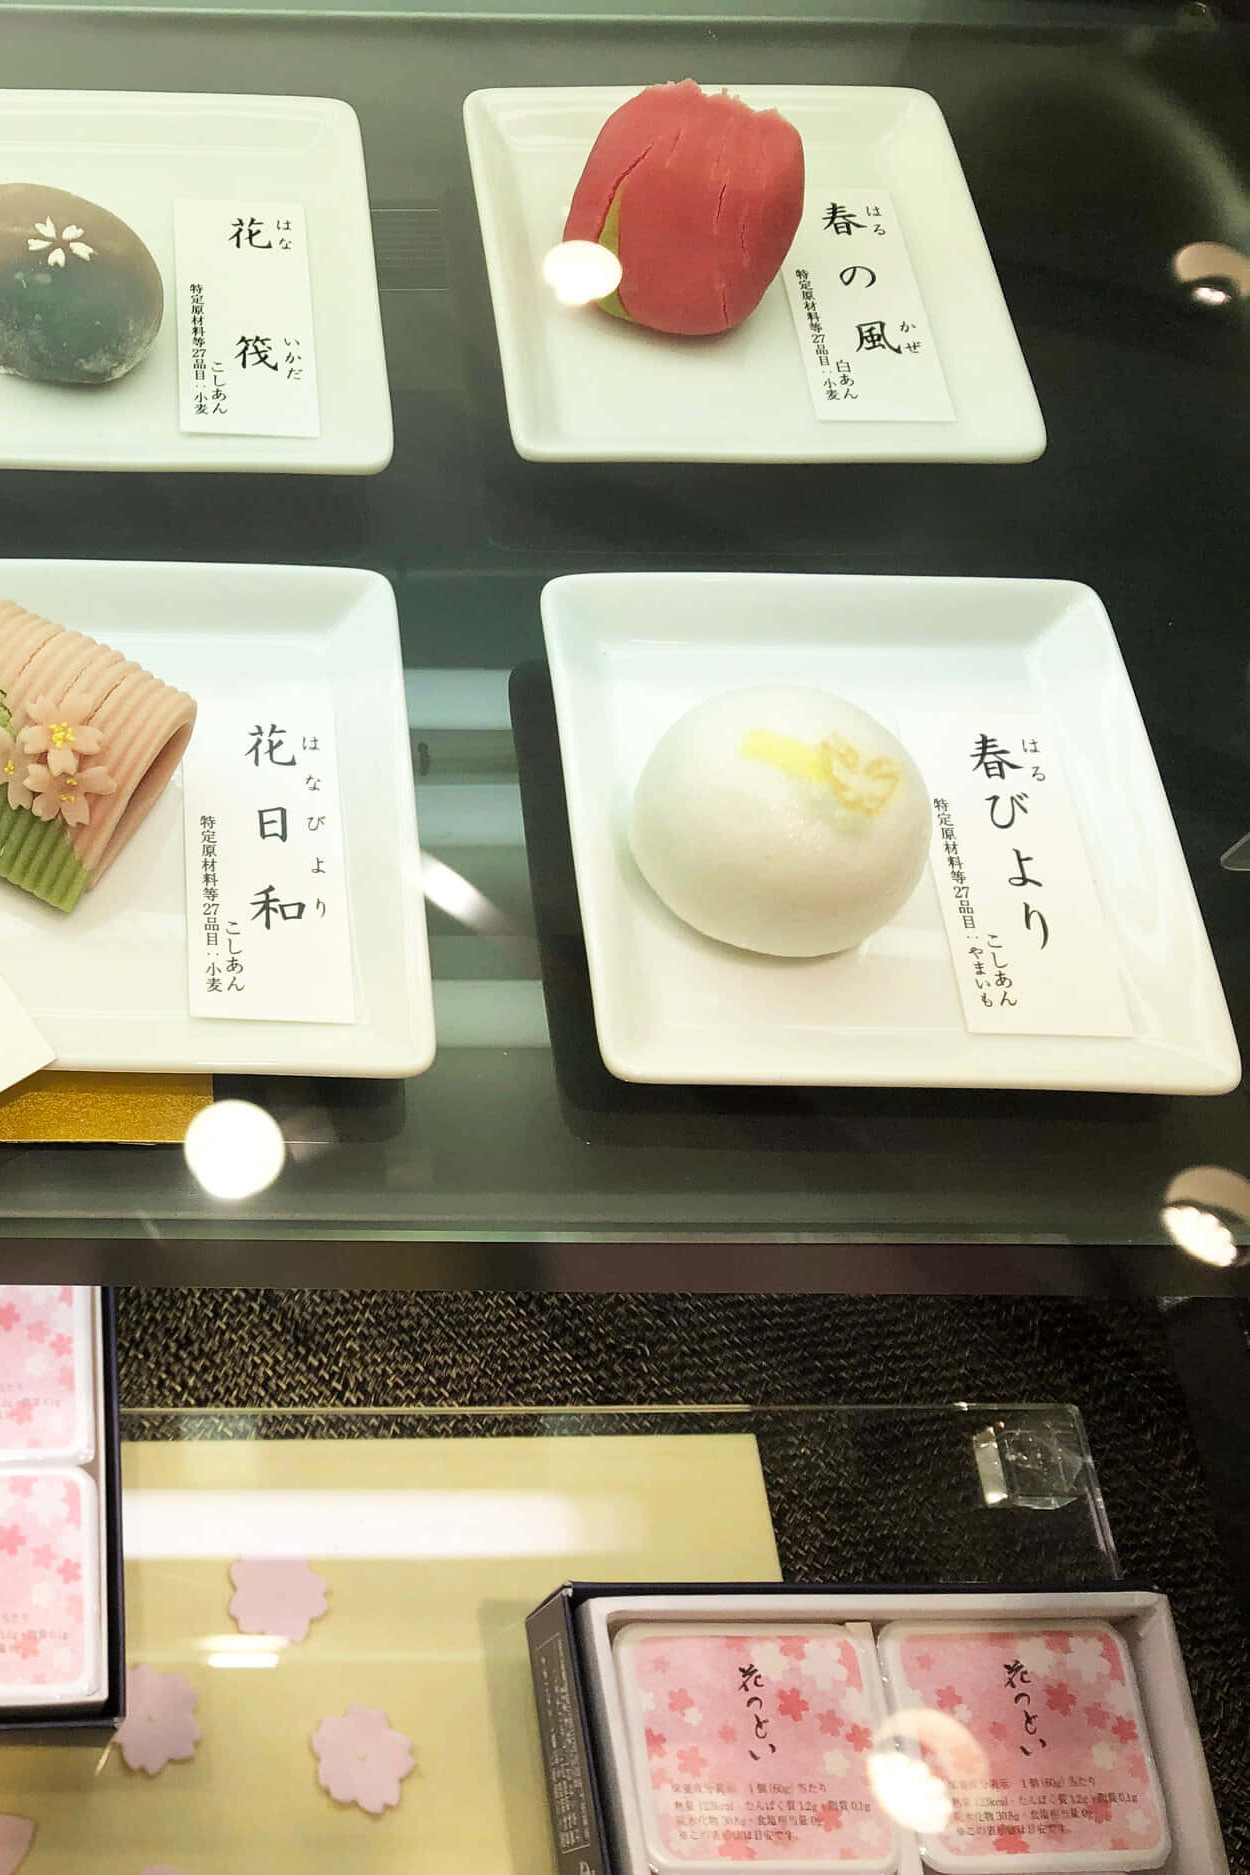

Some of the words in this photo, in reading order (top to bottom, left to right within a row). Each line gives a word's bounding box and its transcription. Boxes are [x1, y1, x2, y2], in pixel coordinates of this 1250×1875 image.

[276, 219, 292, 250] はな
[866, 205, 887, 236] はる
[821, 202, 902, 354] 春の風
[284, 337, 303, 380] いかだ
[900, 320, 921, 354] かぜ
[211, 361, 228, 415] こしあん
[836, 359, 859, 400] 白あん
[1022, 738, 1046, 782] はる
[244, 723, 307, 930] 花日和
[302, 736, 326, 919] はなびより
[969, 733, 1050, 950] 春びより
[225, 920, 246, 992] こしあん
[987, 934, 1017, 1007] こしあん
[738, 1663, 777, 1761] 花つどい
[1003, 1660, 1047, 1757] 花つどい
